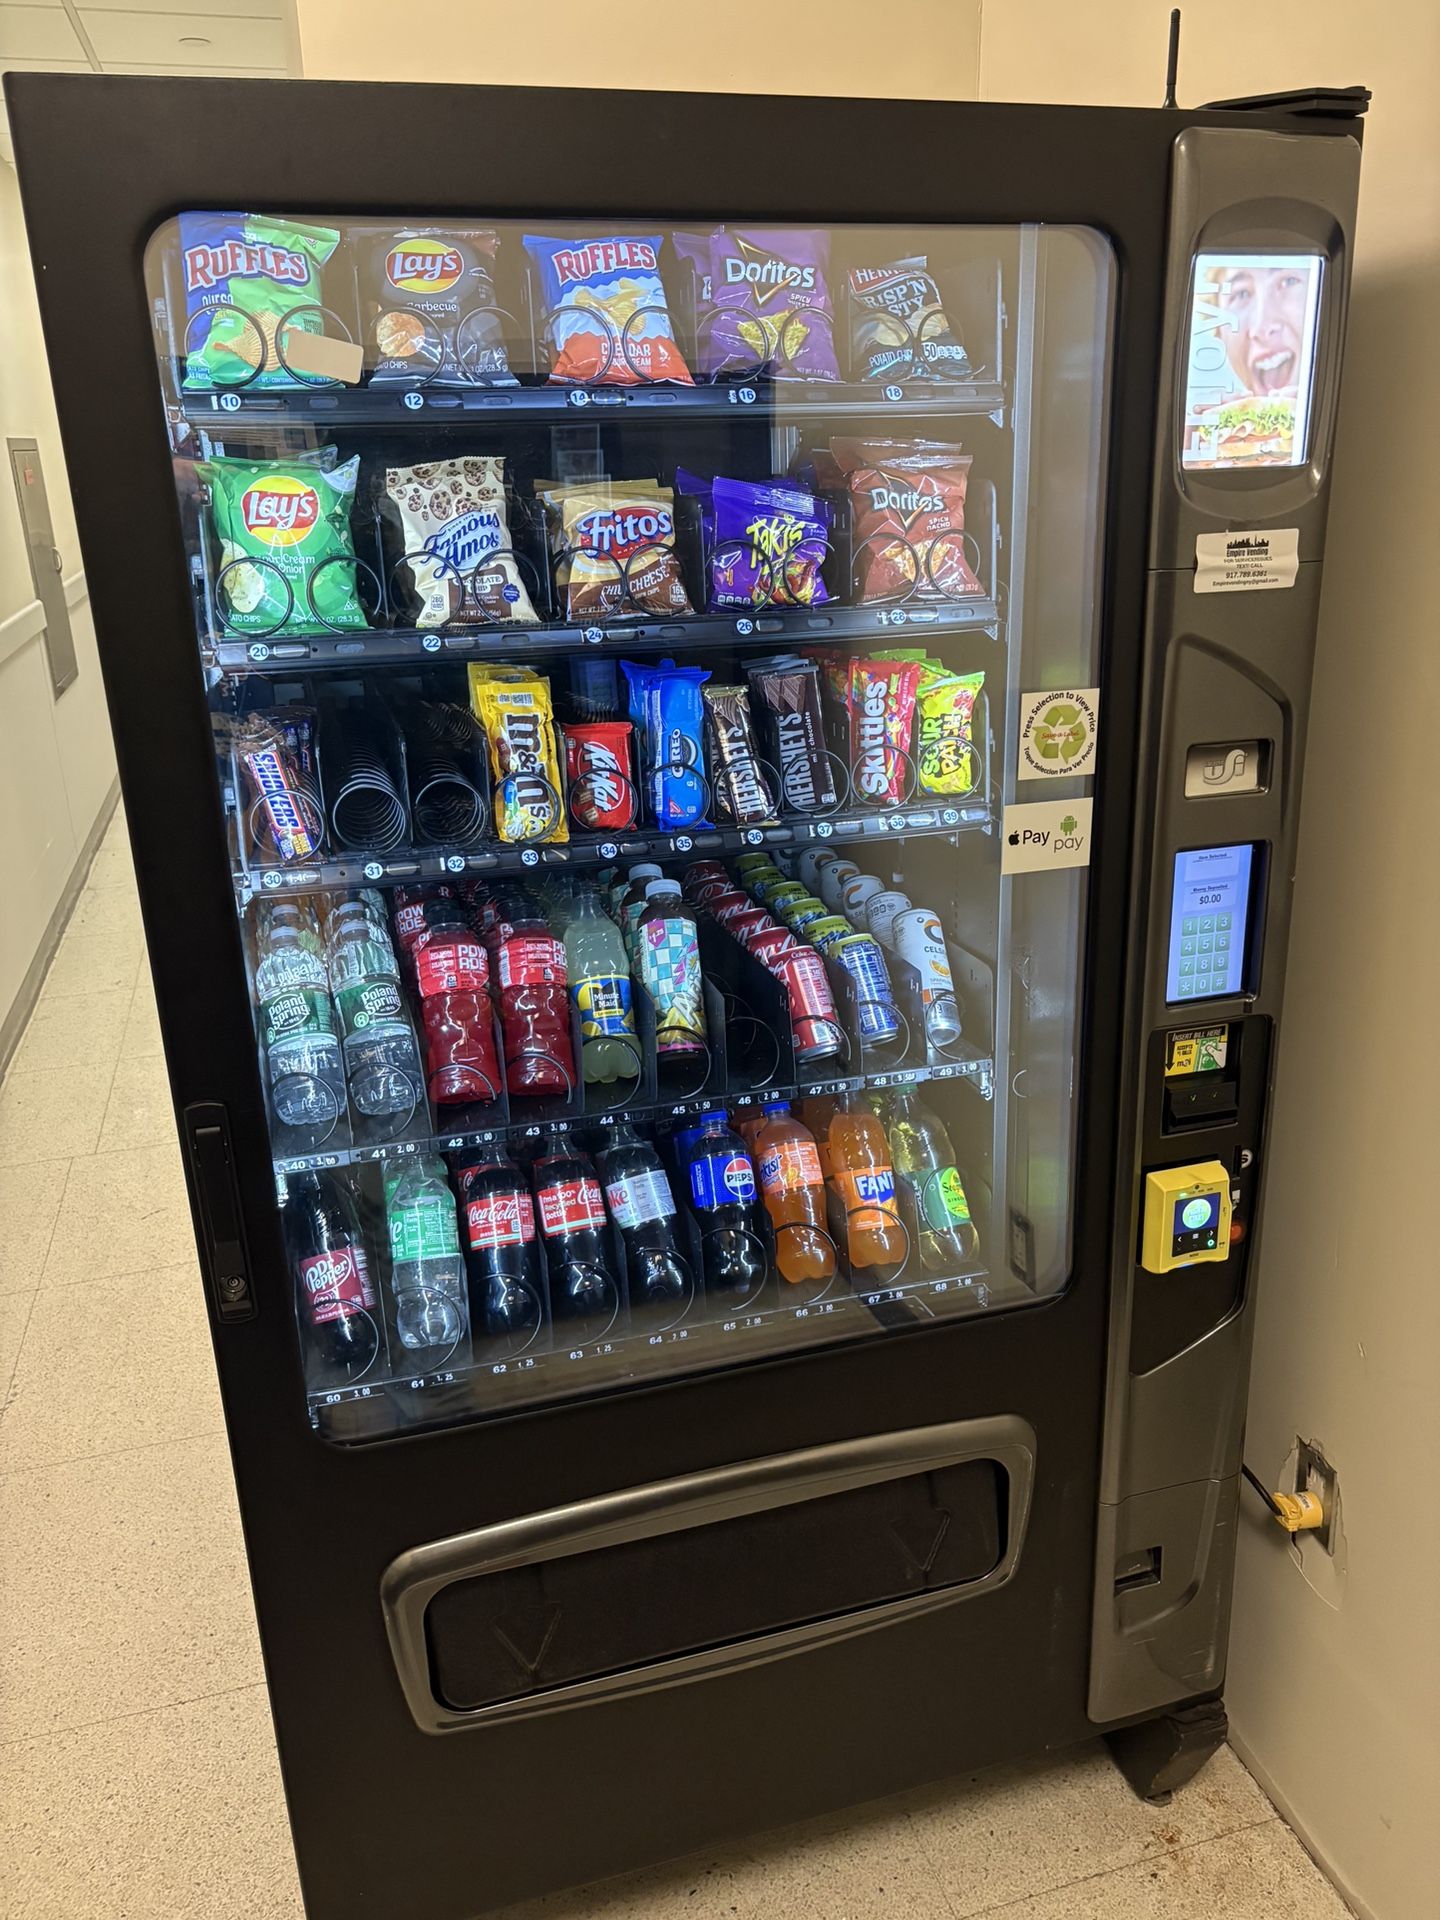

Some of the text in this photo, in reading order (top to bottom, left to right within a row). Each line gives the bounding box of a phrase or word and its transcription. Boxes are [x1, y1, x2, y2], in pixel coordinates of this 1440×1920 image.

[185, 240, 308, 290] RUFFLES
[393, 250, 459, 282] Lay's
[552, 243, 657, 286] RUFFLES
[726, 258, 815, 288] Doritos
[571, 392, 586, 403] 14
[741, 390, 755, 401] 16
[887, 388, 901, 398] 18
[222, 396, 239, 408] 10
[406, 395, 422, 406] 12
[871, 487, 945, 512] Doritos
[247, 490, 315, 530] Lay's
[420, 511, 501, 564] Famous
[576, 510, 672, 556] Fritos
[433, 531, 499, 579] Amos
[1226, 547, 1269, 558] Empire Vending
[629, 565, 670, 593] CHEESE
[738, 621, 751, 632] 26
[588, 629, 602, 640] 24
[424, 637, 440, 648] 22
[252, 646, 268, 658] 20
[1022, 691, 1097, 738] Press Selection to View Price
[804, 711, 816, 747] chocolate
[859, 680, 890, 795] Skittles
[921, 717, 944, 776] SOUR
[671, 728, 684, 778] OREO
[779, 711, 817, 808] HERSHEY'S
[1023, 745, 1035, 765] Toque
[1033, 761, 1059, 775] Seleccion
[1059, 766, 1073, 775] Para
[1072, 759, 1083, 769] Ver
[725, 726, 762, 817] HERSHEY'S
[253, 752, 300, 830] SNICKERS
[944, 811, 958, 822] 39
[818, 825, 833, 835] 37
[748, 831, 762, 842] 36
[1022, 829, 1084, 854] Pay pay
[677, 838, 691, 849] 35
[602, 845, 617, 856] 34
[523, 852, 538, 863] 33
[449, 858, 464, 869] 32
[366, 865, 381, 876] 31
[265, 874, 281, 885] 30
[1199, 893, 1222, 905] $0.00
[458, 957, 486, 970] ADE
[360, 984, 399, 1006] Poland
[593, 992, 620, 1002] Minute
[268, 992, 307, 1018] Poland
[364, 995, 402, 1016] Spring
[598, 1000, 618, 1009] Maid
[271, 1004, 311, 1031] Spring
[1172, 1031, 1193, 1042] INSERT
[1206, 1028, 1223, 1037] HERE
[939, 1067, 953, 1077] 49
[873, 1077, 887, 1086] 48
[809, 1086, 823, 1095] 47
[738, 1096, 752, 1105] 46
[672, 1105, 686, 1115] 45
[599, 1115, 614, 1125] 44
[525, 1127, 541, 1137] 43
[448, 1137, 464, 1148] 42
[371, 1148, 387, 1159] 41
[290, 1160, 306, 1171] 40
[726, 1171, 754, 1184] PEPS
[855, 1171, 894, 1197] FANT
[469, 1198, 520, 1227] Coca-Cola
[315, 1258, 334, 1276] Dr
[306, 1260, 348, 1294] Pepper
[934, 1282, 948, 1292] 68
[868, 1294, 882, 1304] 67
[795, 1308, 809, 1318] 66
[723, 1322, 737, 1332] 65
[649, 1335, 663, 1345] 64
[569, 1350, 584, 1361] 63
[492, 1364, 507, 1375] 62
[411, 1379, 425, 1389] 61
[325, 1393, 341, 1404] 60
